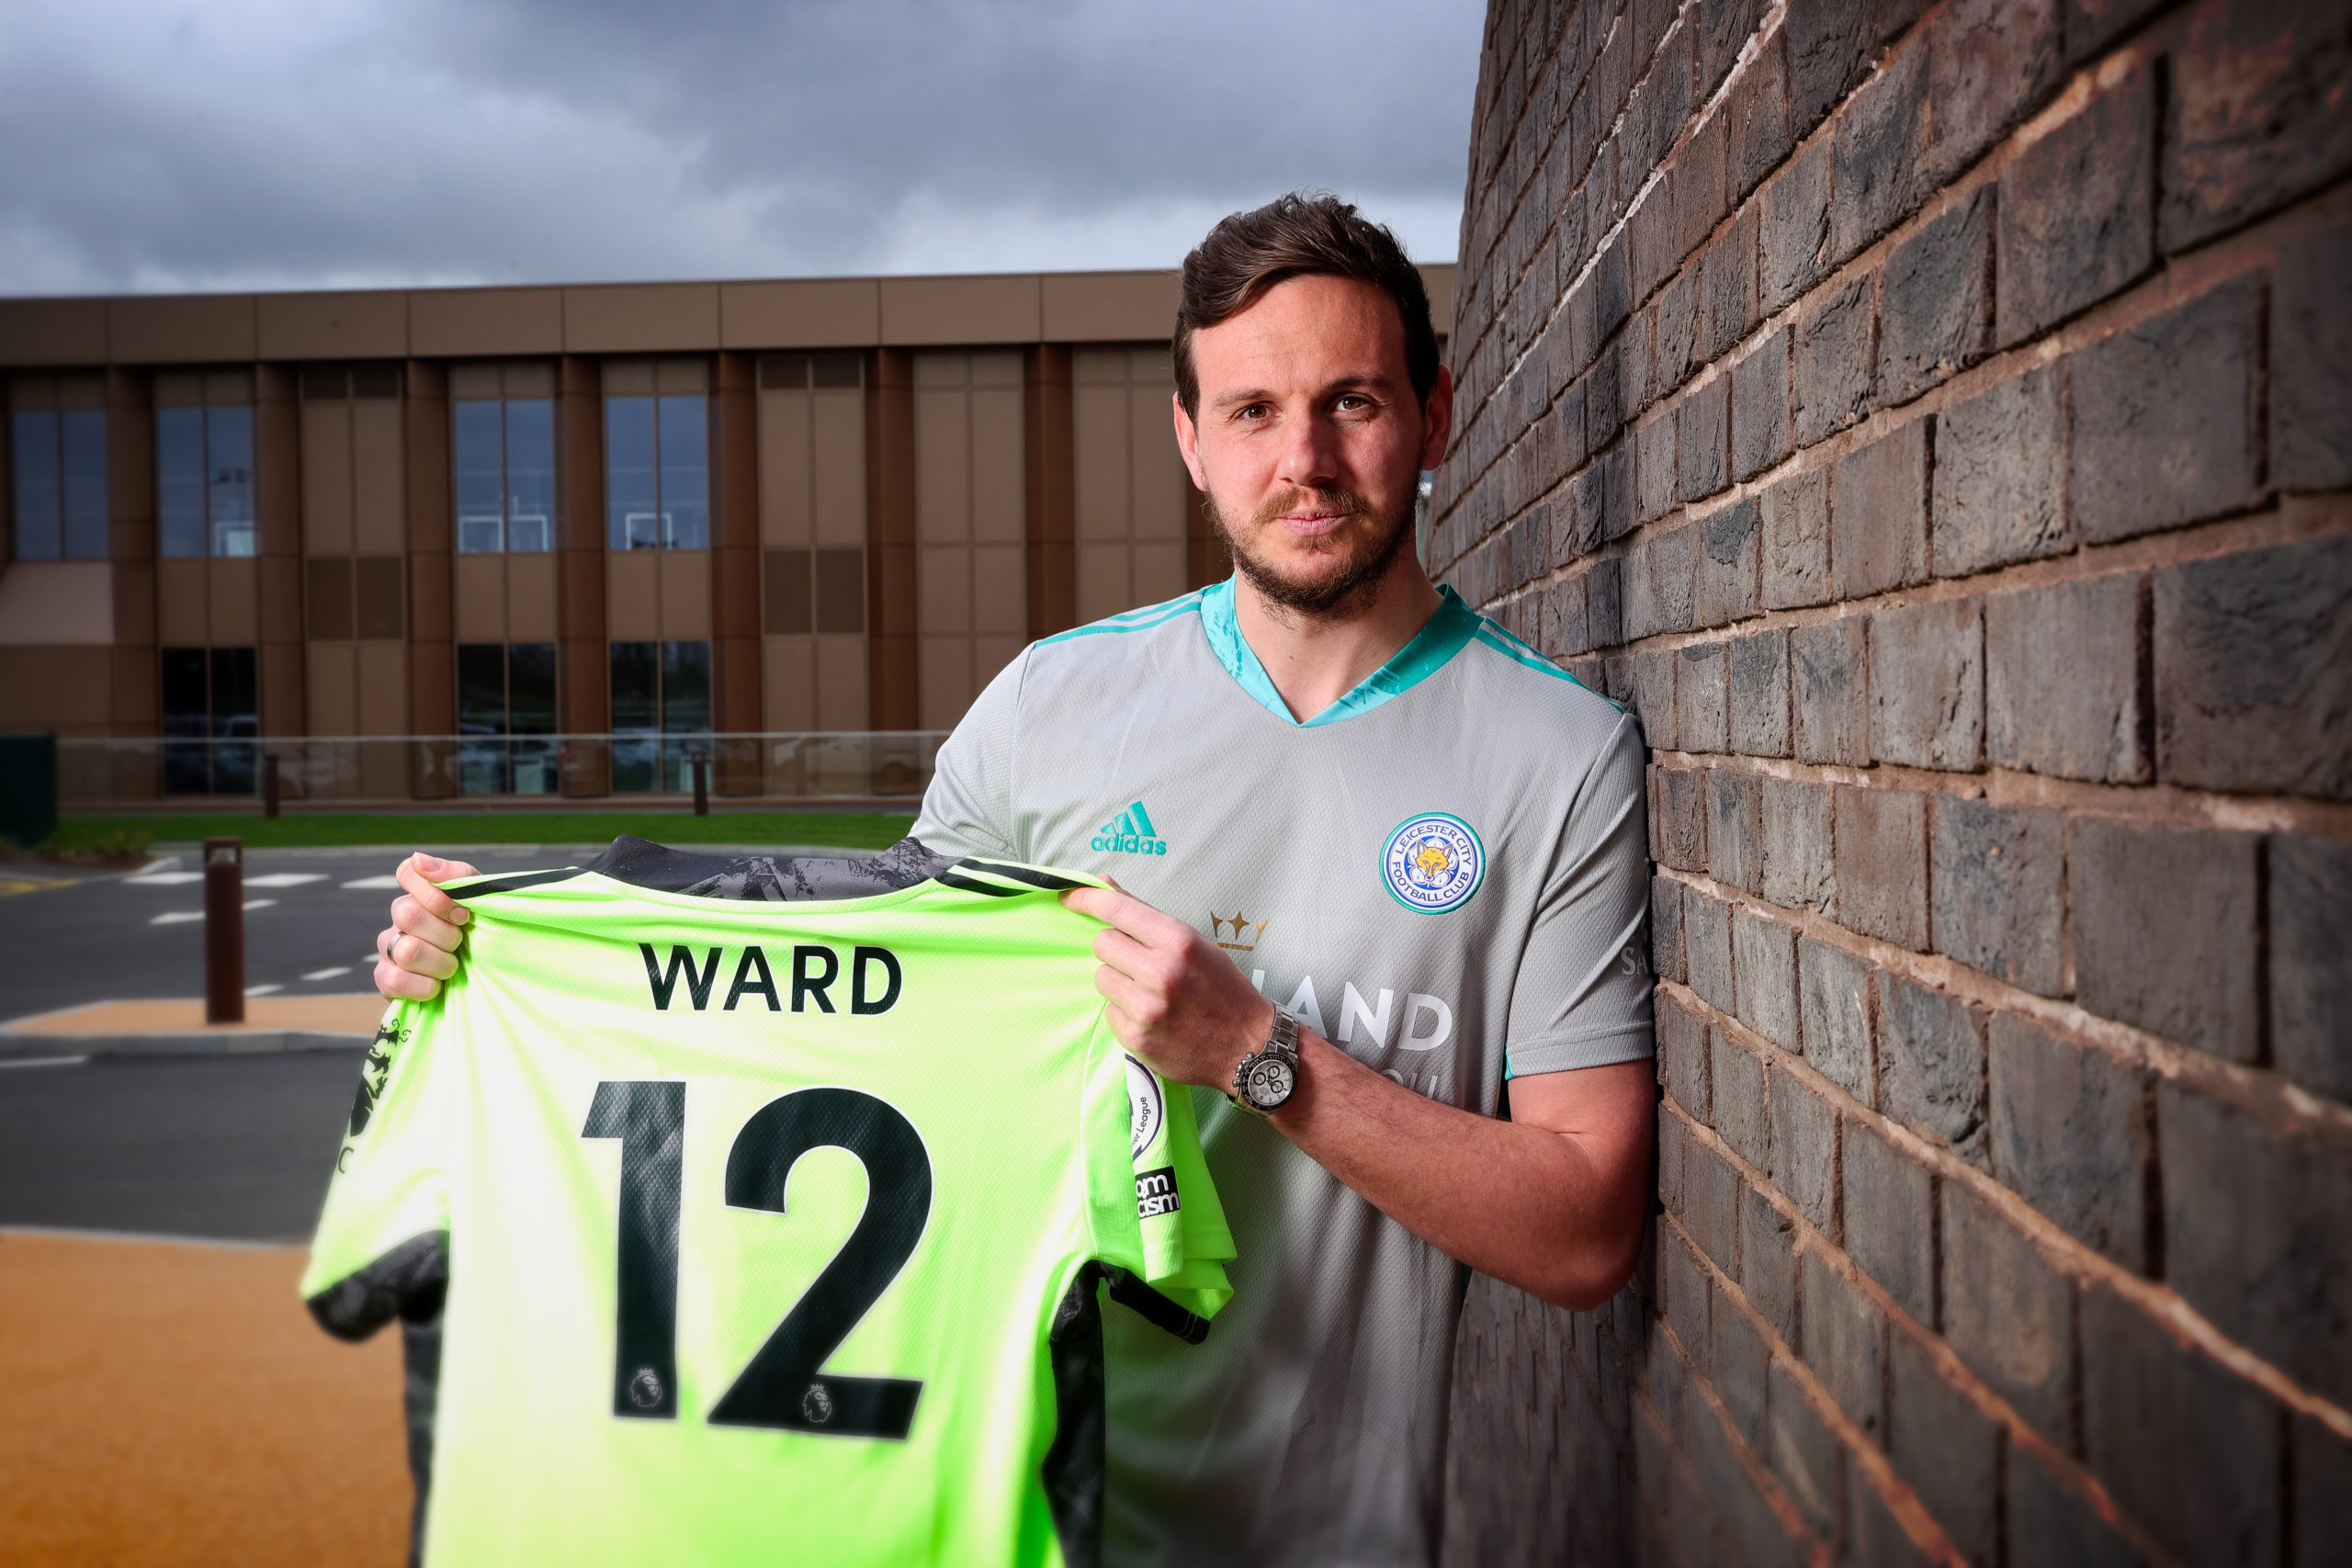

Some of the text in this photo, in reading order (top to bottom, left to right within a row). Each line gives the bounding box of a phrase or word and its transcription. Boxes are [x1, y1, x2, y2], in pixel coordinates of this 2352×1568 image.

[1091, 833, 1167, 855] adidas
[1396, 824, 1472, 865] LEICESTER CITY
[1392, 862, 1470, 902] FOOTBALL CLUB
[638, 942, 902, 1016] WARD
[1136, 1096, 1151, 1134] League
[580, 1080, 933, 1441] 12
